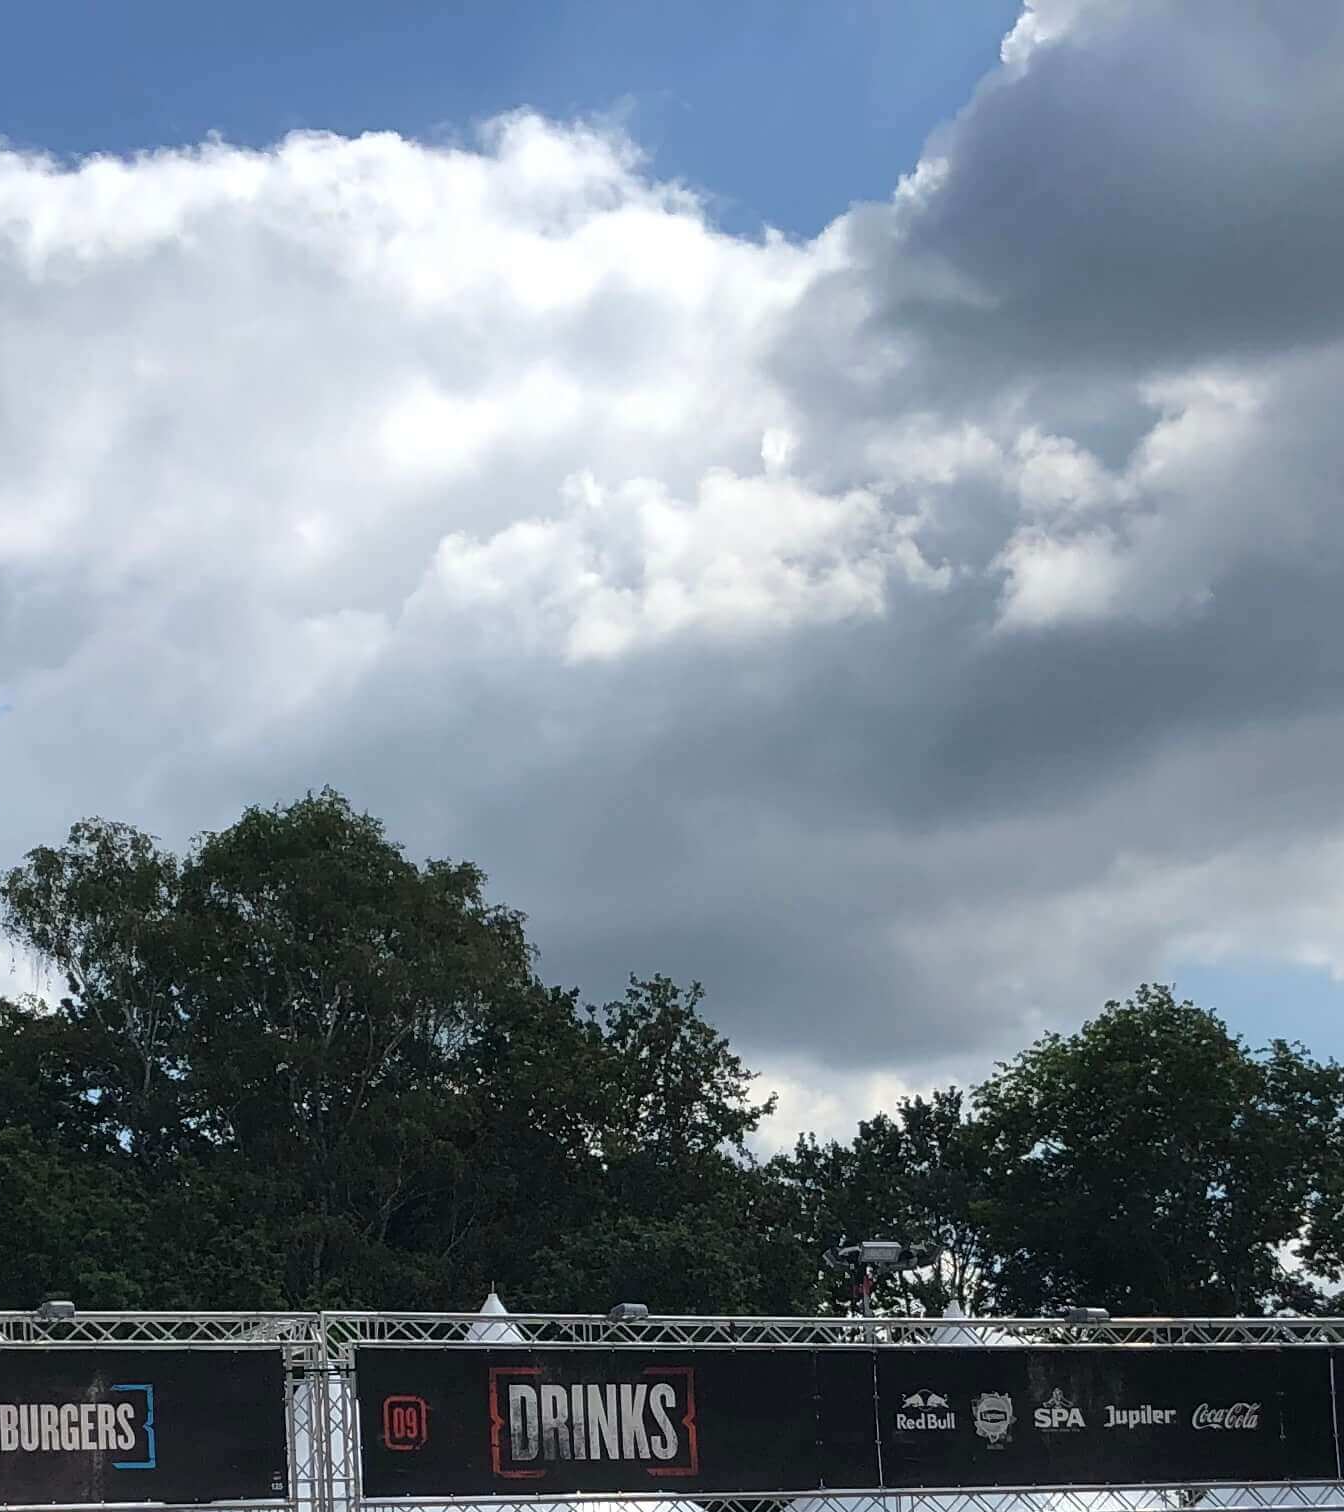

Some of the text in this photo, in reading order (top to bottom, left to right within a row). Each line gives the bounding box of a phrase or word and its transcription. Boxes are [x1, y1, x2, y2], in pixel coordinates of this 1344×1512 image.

[0, 1403, 136, 1452] BURGERS
[392, 1407, 418, 1439] 09
[508, 1383, 679, 1461] DRINKS
[1034, 1408, 1086, 1427] SPA
[1103, 1404, 1177, 1429] Jupiler
